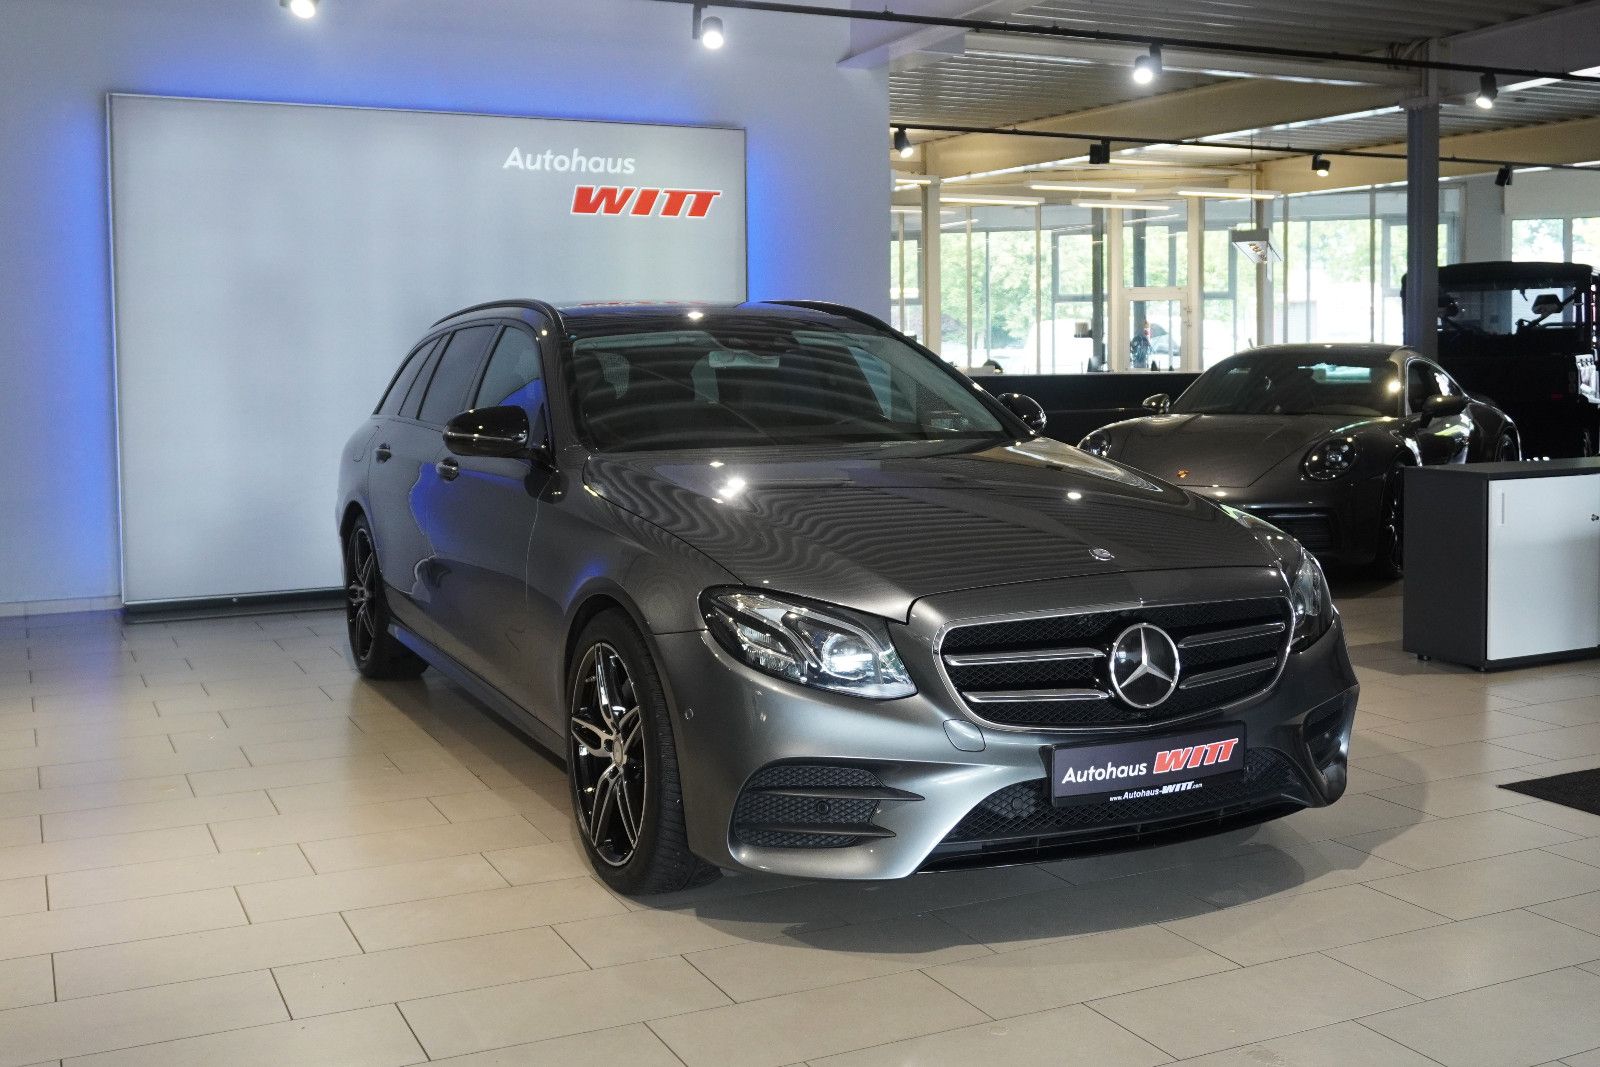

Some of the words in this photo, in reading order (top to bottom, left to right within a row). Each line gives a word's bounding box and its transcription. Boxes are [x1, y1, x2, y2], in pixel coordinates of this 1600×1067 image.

[503, 146, 636, 175] Autohaus
[570, 184, 723, 218] WITT
[1061, 762, 1148, 784] Autohaus
[1152, 738, 1239, 775] WITT
[1109, 780, 1203, 802] www.Autohaus-WITT.com
